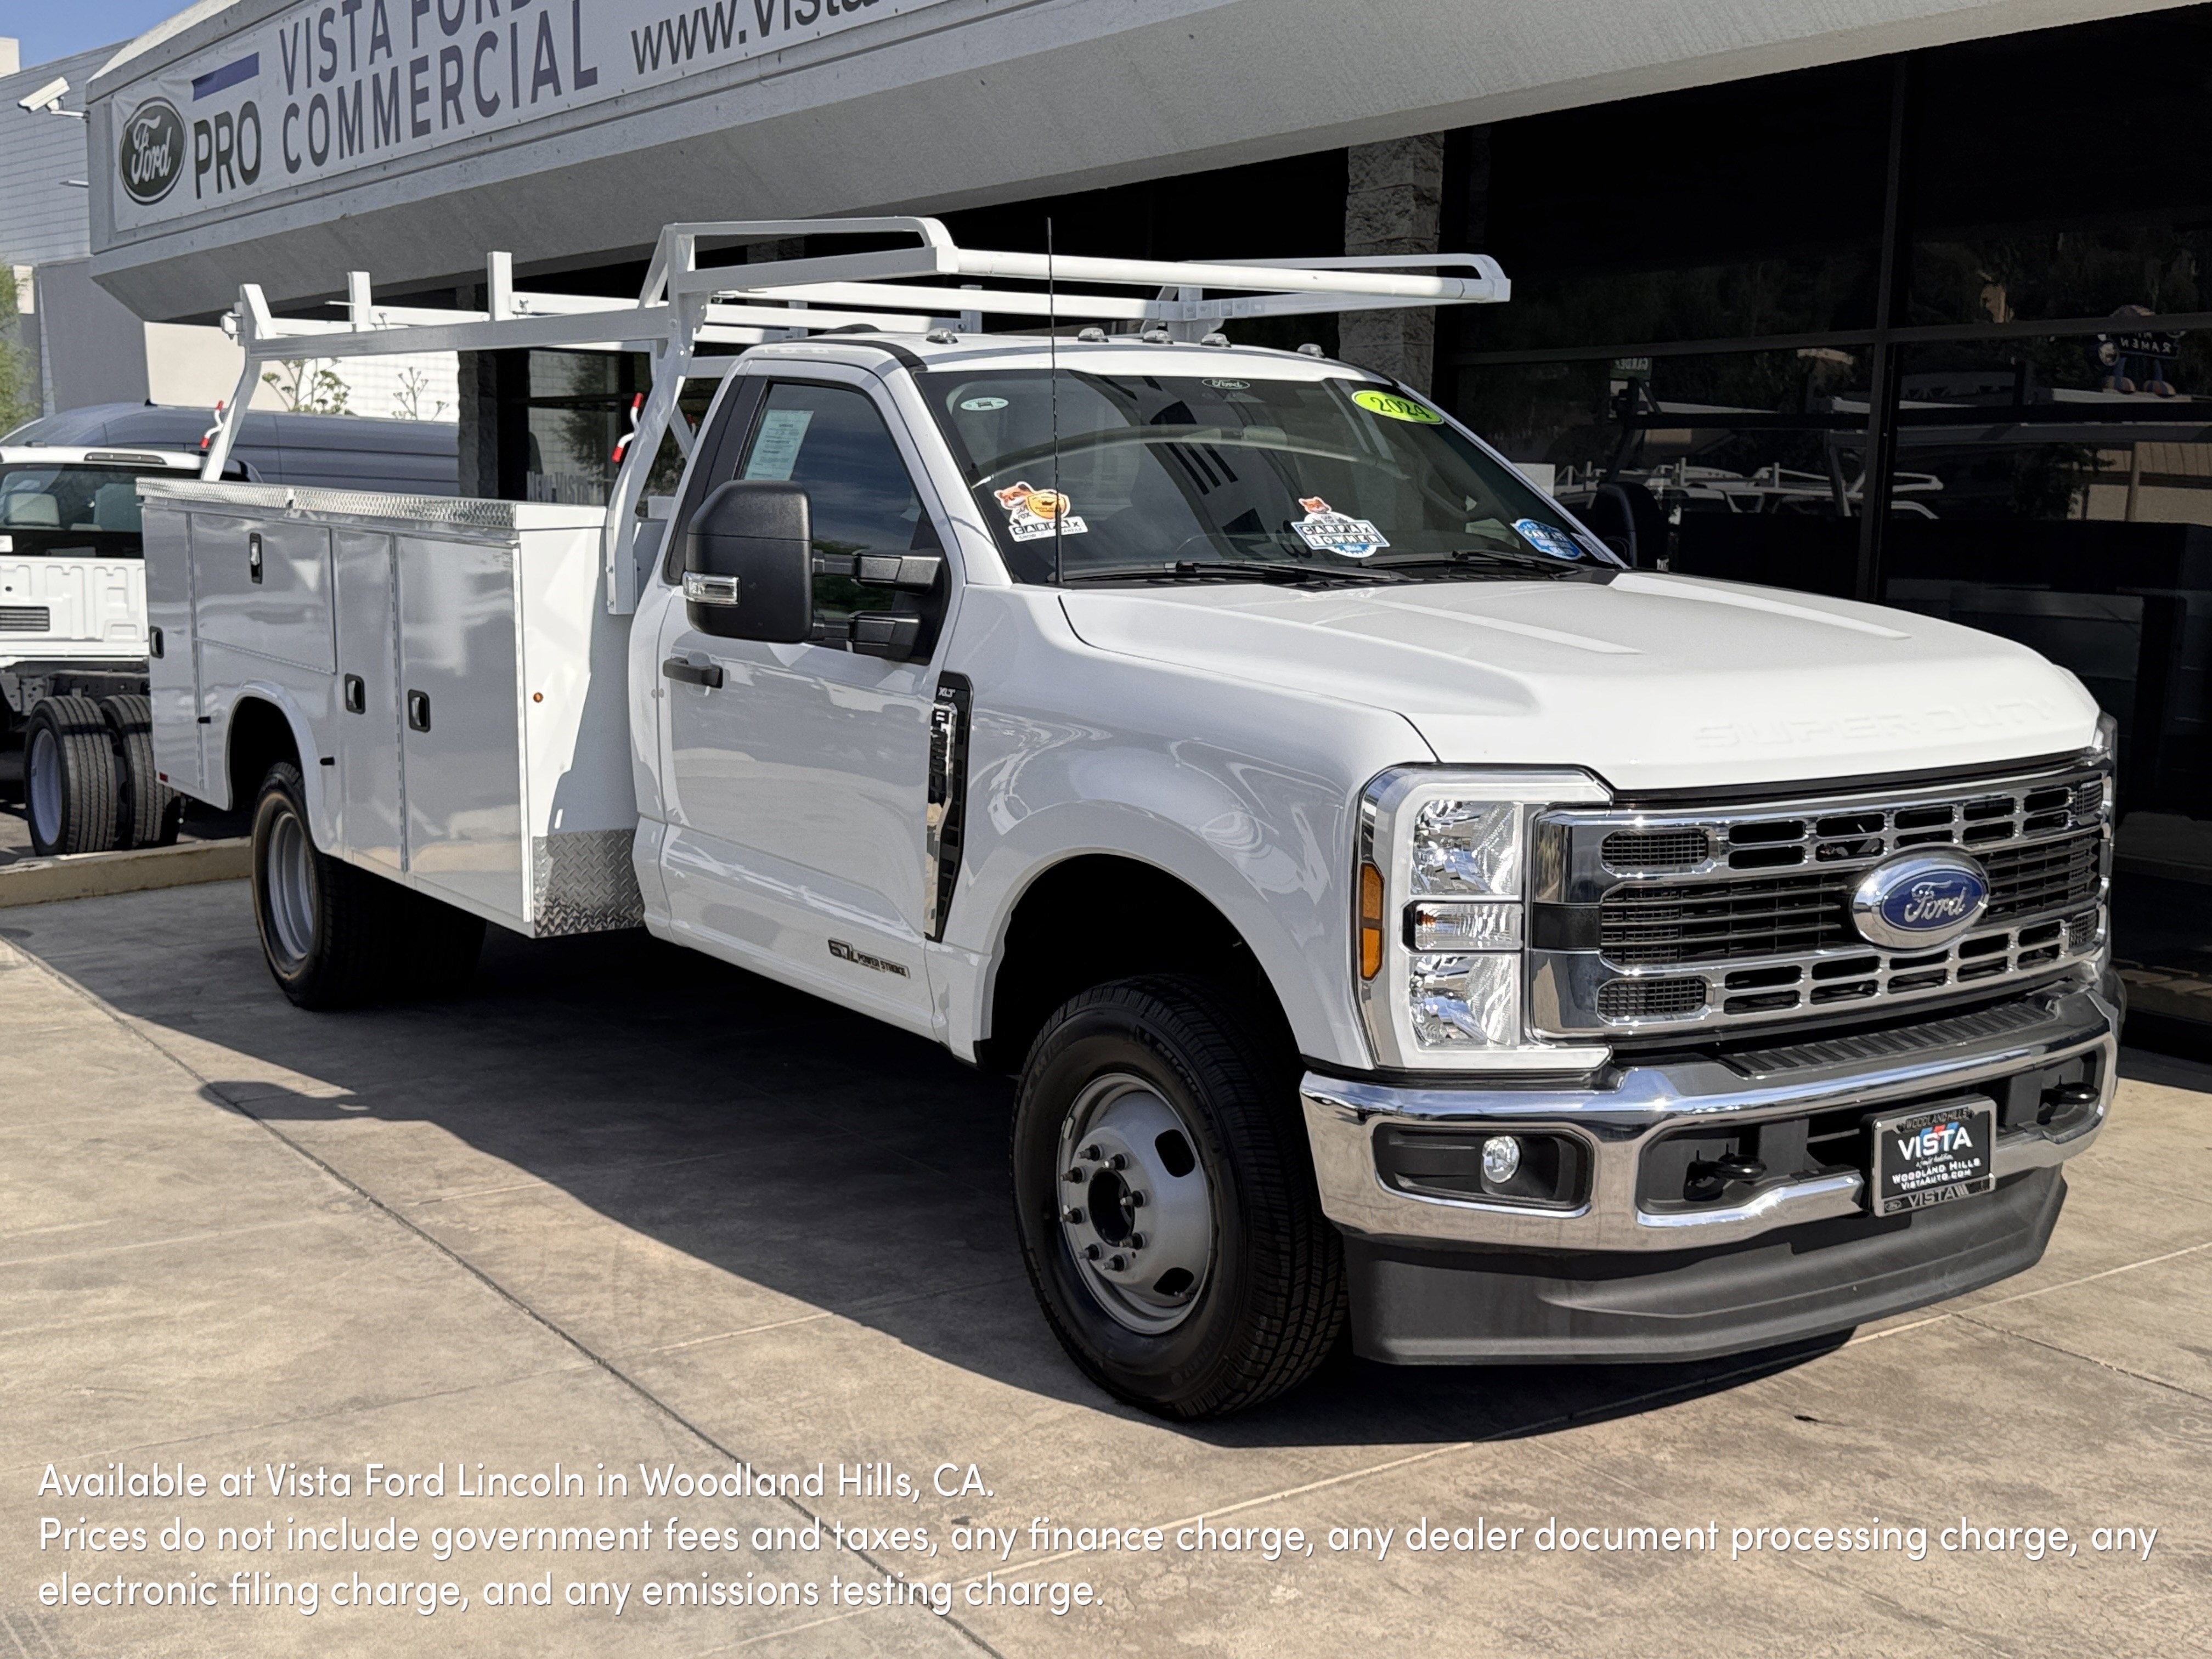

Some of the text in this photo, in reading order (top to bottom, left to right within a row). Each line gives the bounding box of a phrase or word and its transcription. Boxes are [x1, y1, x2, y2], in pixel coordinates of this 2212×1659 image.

[279, 0, 393, 95] VISTA
[283, 0, 599, 174] COMMERCIAL
[131, 115, 172, 185] Ford
[194, 100, 262, 200] PRO
[1370, 397, 1432, 419] 2024
[1301, 524, 1373, 535] CARFAX
[1324, 534, 1384, 545] OWNER
[938, 687, 956, 698] XLT
[1903, 879, 1967, 923] Ford
[1898, 1126, 1973, 1161] VISTA
[1908, 1186, 1955, 1207] VISTA
